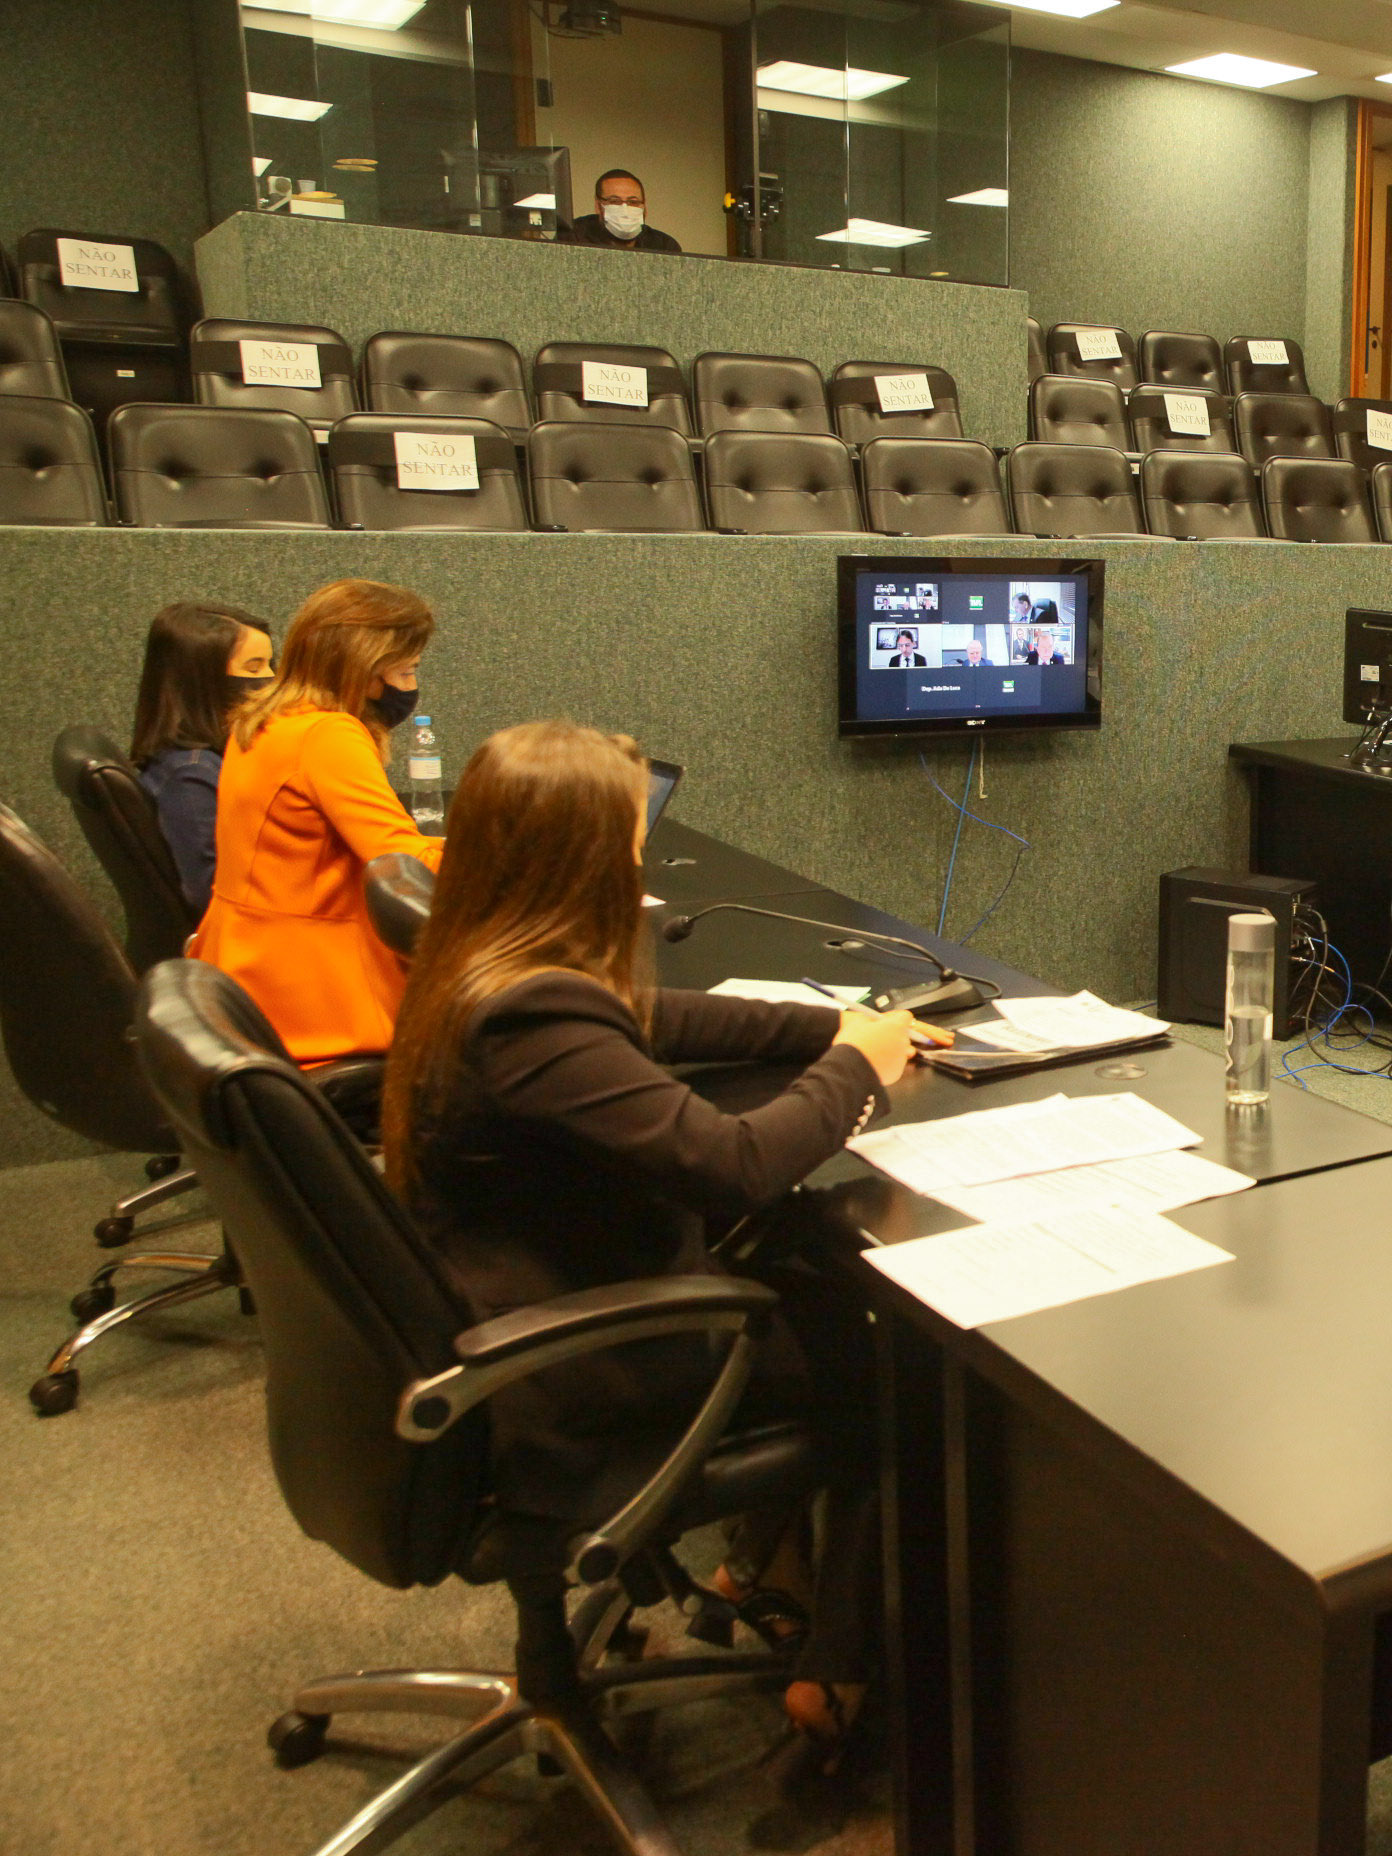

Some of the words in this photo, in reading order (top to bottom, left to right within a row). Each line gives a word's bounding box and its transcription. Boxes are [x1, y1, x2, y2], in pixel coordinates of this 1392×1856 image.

[79, 248, 116, 262] NÃO
[65, 262, 133, 280] SENTAR
[261, 346, 299, 362] NÃO
[248, 365, 316, 380] SENTAR
[600, 369, 631, 383] NÃO
[587, 384, 644, 400] SENTAR
[889, 379, 916, 391] NÃO
[883, 394, 929, 406] SENTAR
[1176, 400, 1197, 412] NÃO
[1170, 414, 1207, 425] SENTAR
[417, 441, 455, 457] NÃO
[403, 461, 472, 476] SENTAR
